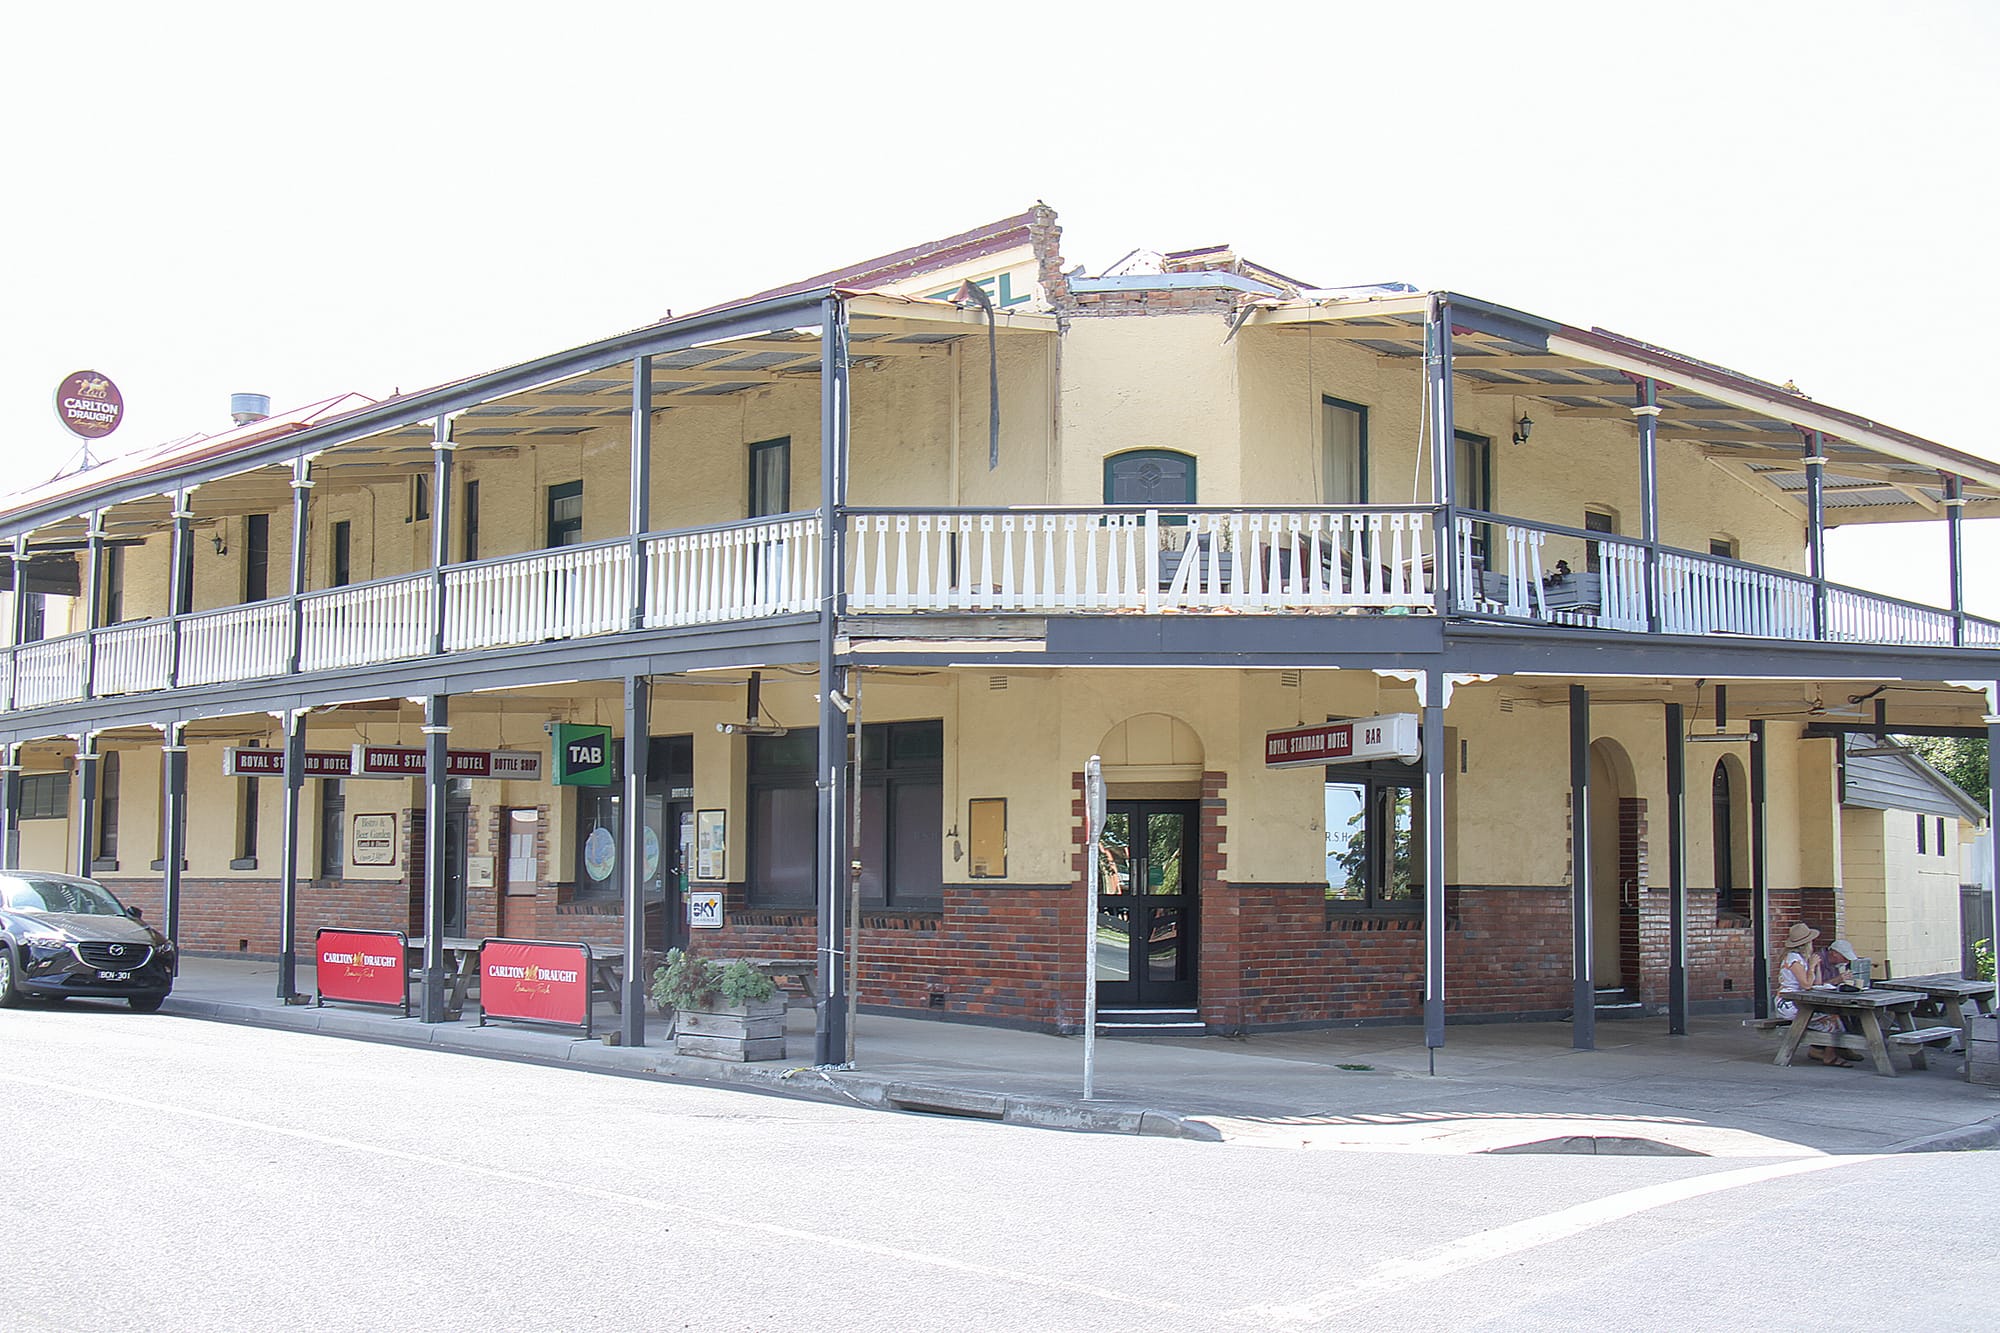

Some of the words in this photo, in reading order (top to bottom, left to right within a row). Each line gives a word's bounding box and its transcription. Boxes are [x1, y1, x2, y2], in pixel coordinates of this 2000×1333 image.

[64, 398, 118, 415] CARLTON
[68, 409, 115, 422] DRAUGHT
[1268, 739, 1288, 755] ROYAL
[1290, 734, 1325, 752] STANDARD
[1327, 732, 1348, 749] HOTEL
[1366, 728, 1381, 745] BAR
[240, 755, 269, 768] ROYAL
[273, 756, 319, 769] STARD
[323, 758, 349, 770] HOTEL
[370, 753, 399, 767] ROYAL
[457, 757, 484, 770] HOTEL
[569, 746, 602, 763] TAB
[494, 758, 518, 770] BOTTLE
[520, 759, 537, 771] SHOP
[693, 902, 718, 917] SKY
[323, 952, 353, 964] CARLTON
[364, 955, 396, 967] DRAUGHT
[489, 965, 525, 978] CARLTON
[538, 968, 577, 983] DRAUGHT
